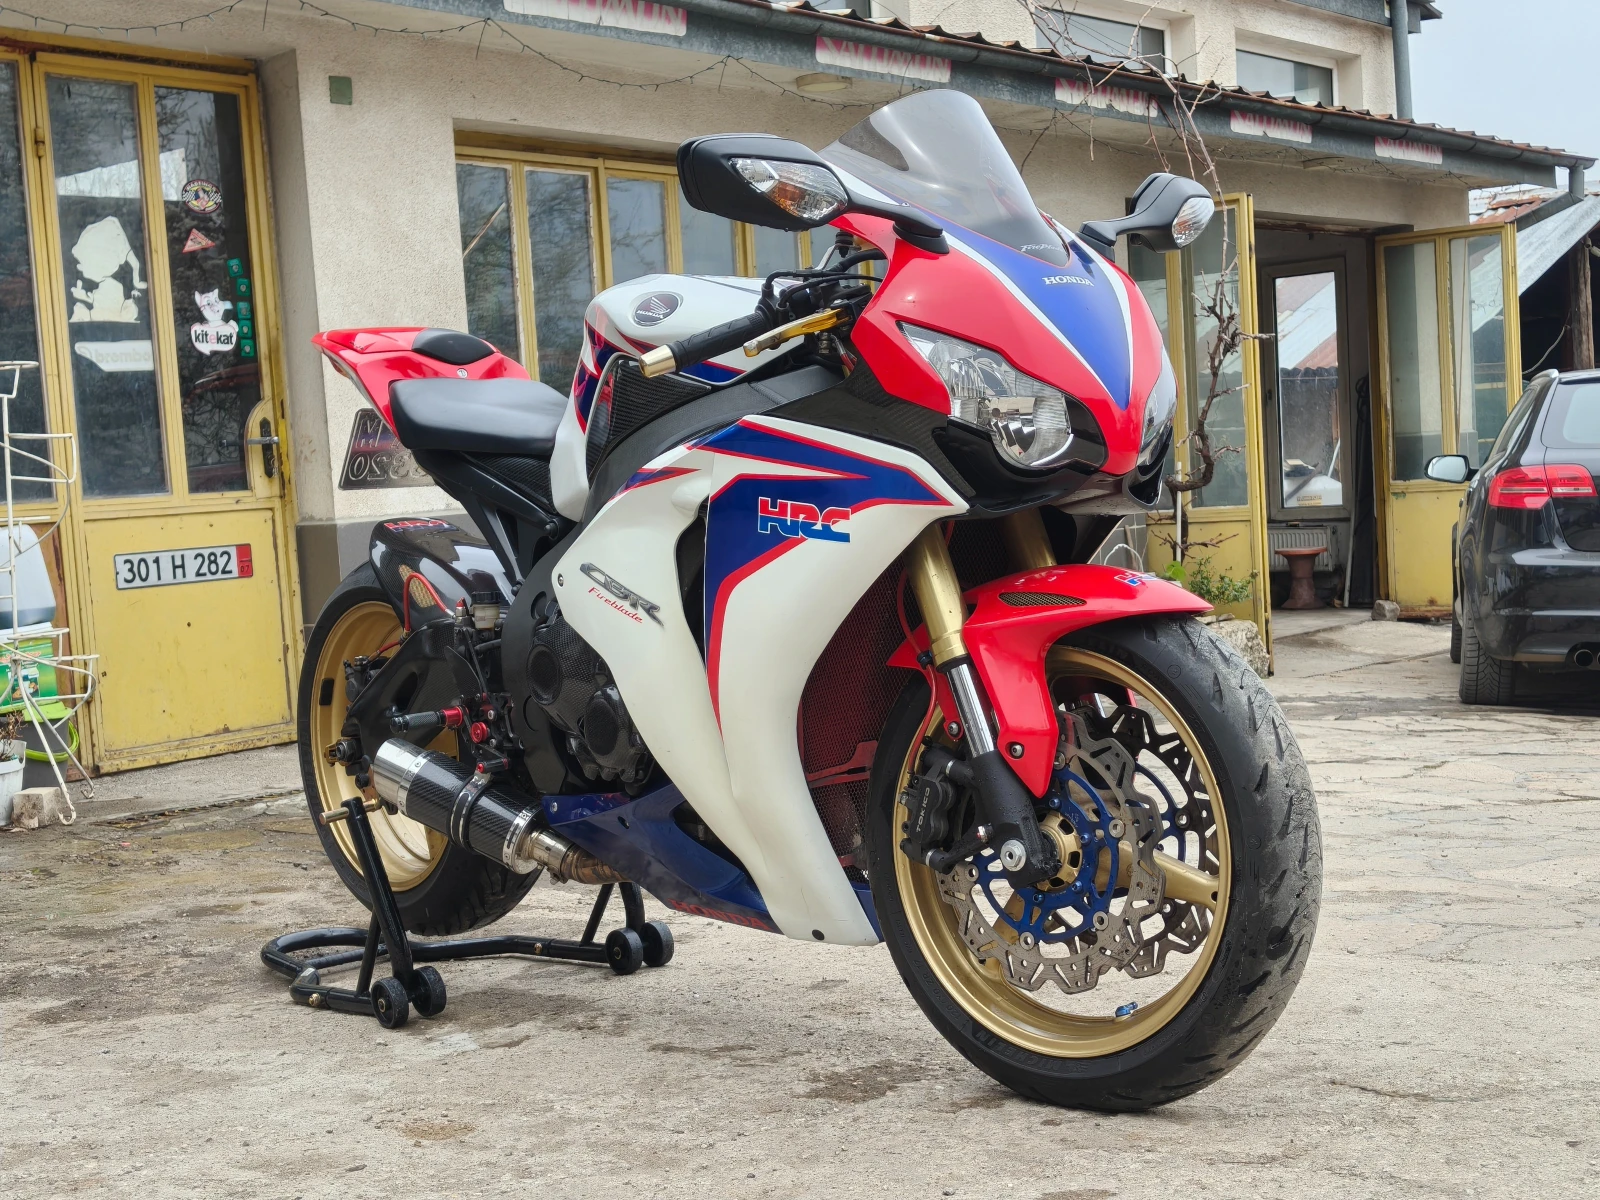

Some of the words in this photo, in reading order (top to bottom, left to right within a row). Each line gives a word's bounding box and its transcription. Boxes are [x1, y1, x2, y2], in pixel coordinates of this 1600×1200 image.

[1042, 275, 1094, 287] HONDA
[636, 309, 664, 319] HONDA
[194, 329, 235, 345] kitekat
[758, 496, 851, 543] HRC
[123, 555, 161, 584] 301
[171, 553, 187, 580] H
[193, 550, 233, 578] 282
[240, 564, 250, 573] 07
[579, 562, 664, 628] CBR
[588, 586, 643, 624] Fireblade
[916, 787, 931, 833] TOKICO
[666, 898, 775, 932] HONDA
[975, 1030, 1064, 1072] MICHELIN
